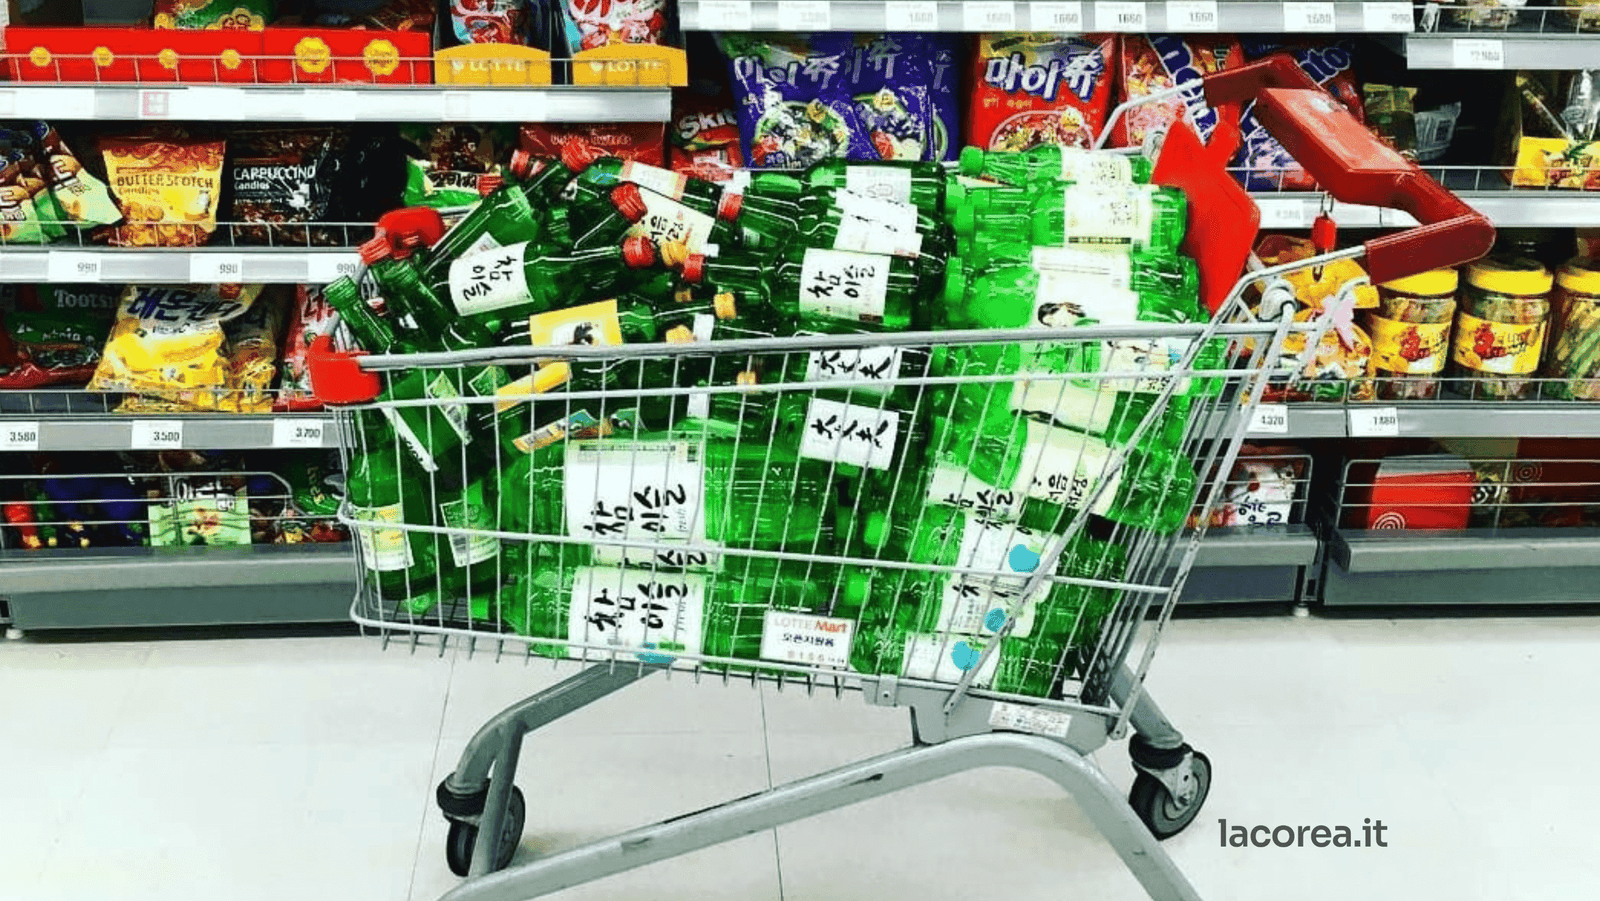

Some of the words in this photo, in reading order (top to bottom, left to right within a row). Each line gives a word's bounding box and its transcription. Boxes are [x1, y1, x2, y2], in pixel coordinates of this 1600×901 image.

[985, 51, 1102, 100] 마이쮸
[233, 164, 317, 181] CAPPUCCINO
[77, 262, 97, 273] 990
[219, 263, 238, 274] 990
[336, 263, 356, 274] 990
[490, 256, 518, 282] 참
[806, 271, 841, 299] 참
[583, 501, 635, 535] 참
[584, 587, 636, 632] 참
[813, 620, 848, 633] Mart
